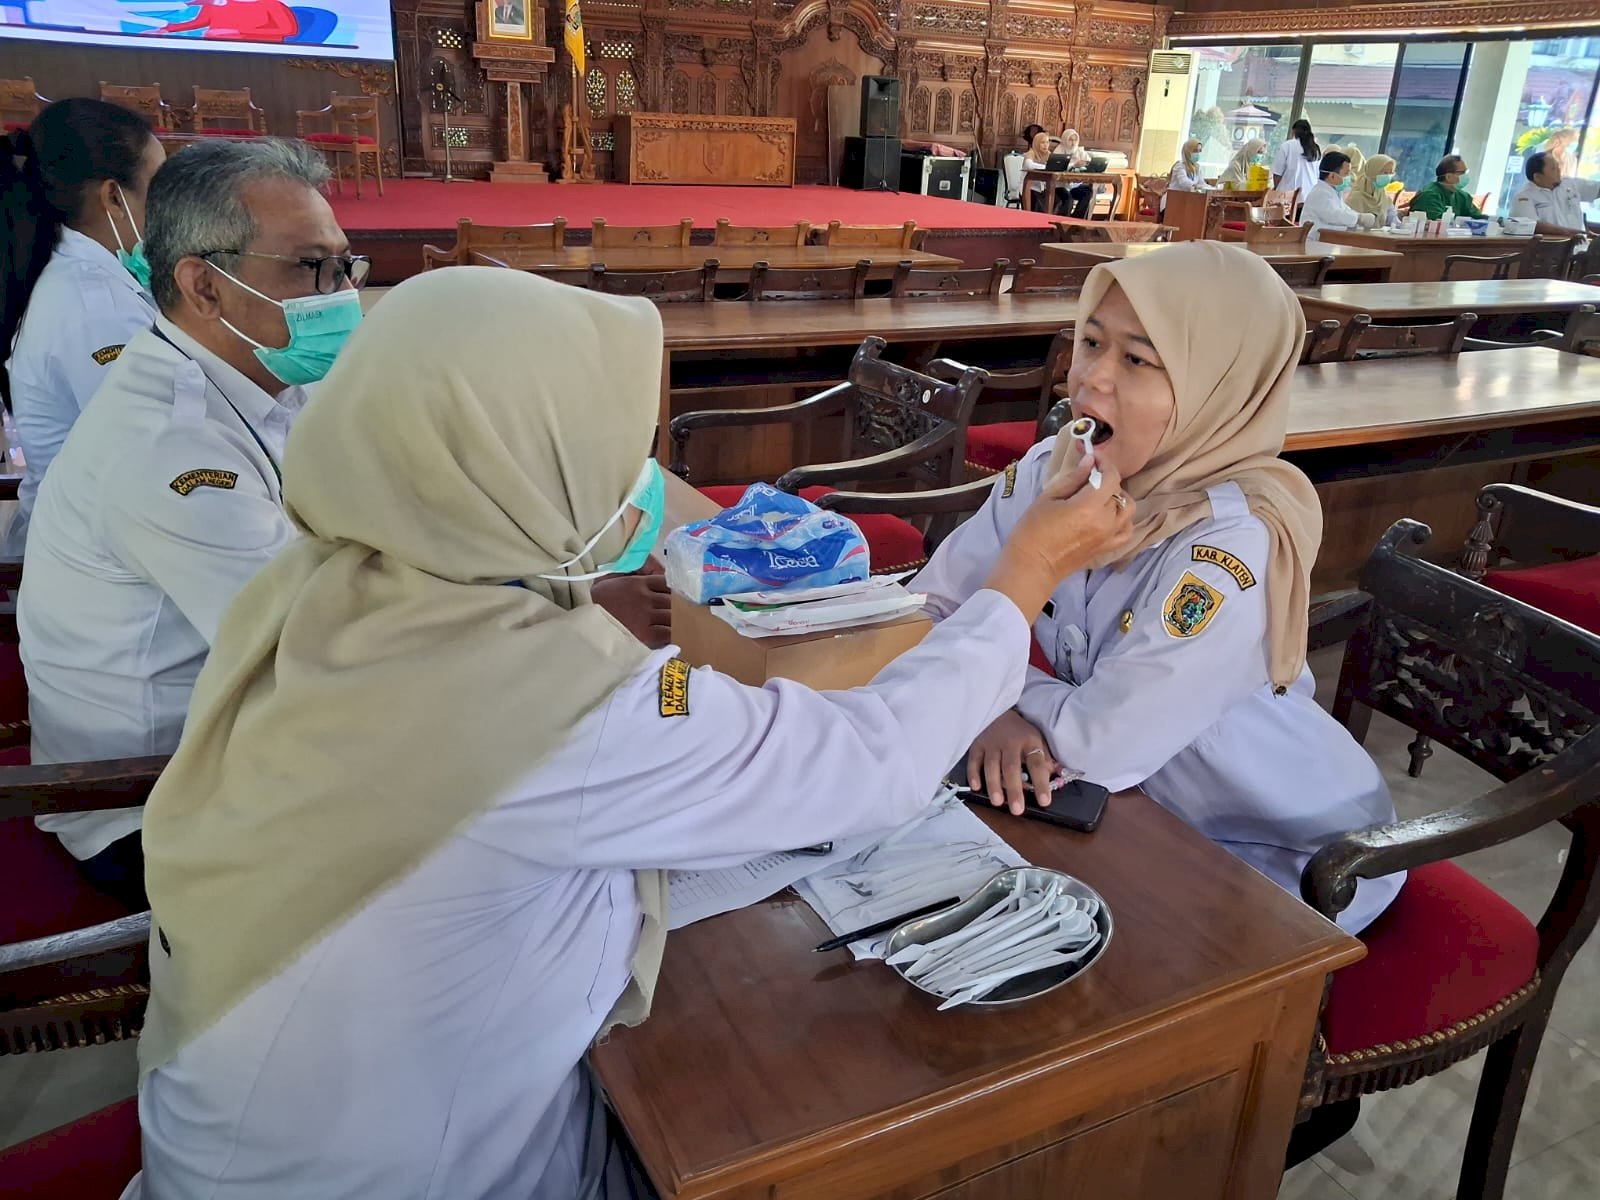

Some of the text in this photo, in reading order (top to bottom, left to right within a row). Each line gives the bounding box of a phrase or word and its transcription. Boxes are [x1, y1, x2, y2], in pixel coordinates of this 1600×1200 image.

[174, 471, 235, 488] KEMENTERIAN
[1220, 554, 1252, 586] KLATEN
[675, 677, 685, 712] DALAM
